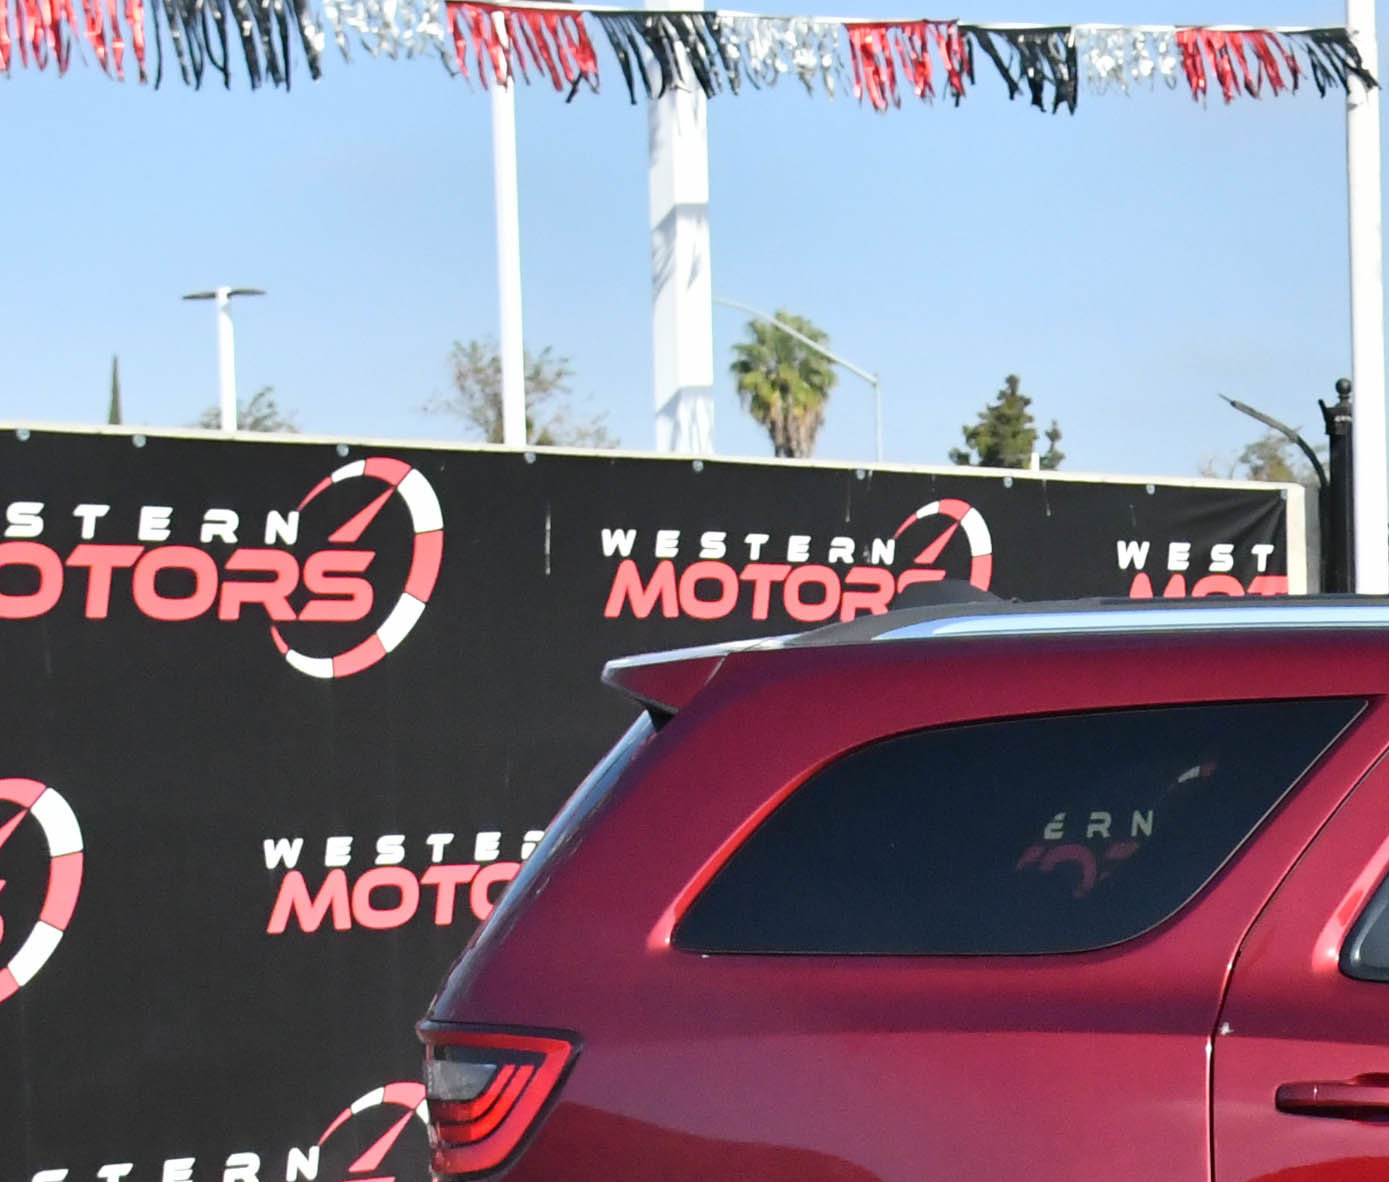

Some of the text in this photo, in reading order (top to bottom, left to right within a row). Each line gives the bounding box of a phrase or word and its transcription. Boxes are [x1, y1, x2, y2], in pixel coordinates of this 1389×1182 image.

[4, 501, 300, 546] STERN
[601, 528, 897, 566] WESTERN
[1116, 540, 1276, 573] WEST
[0, 540, 377, 623] OTORS
